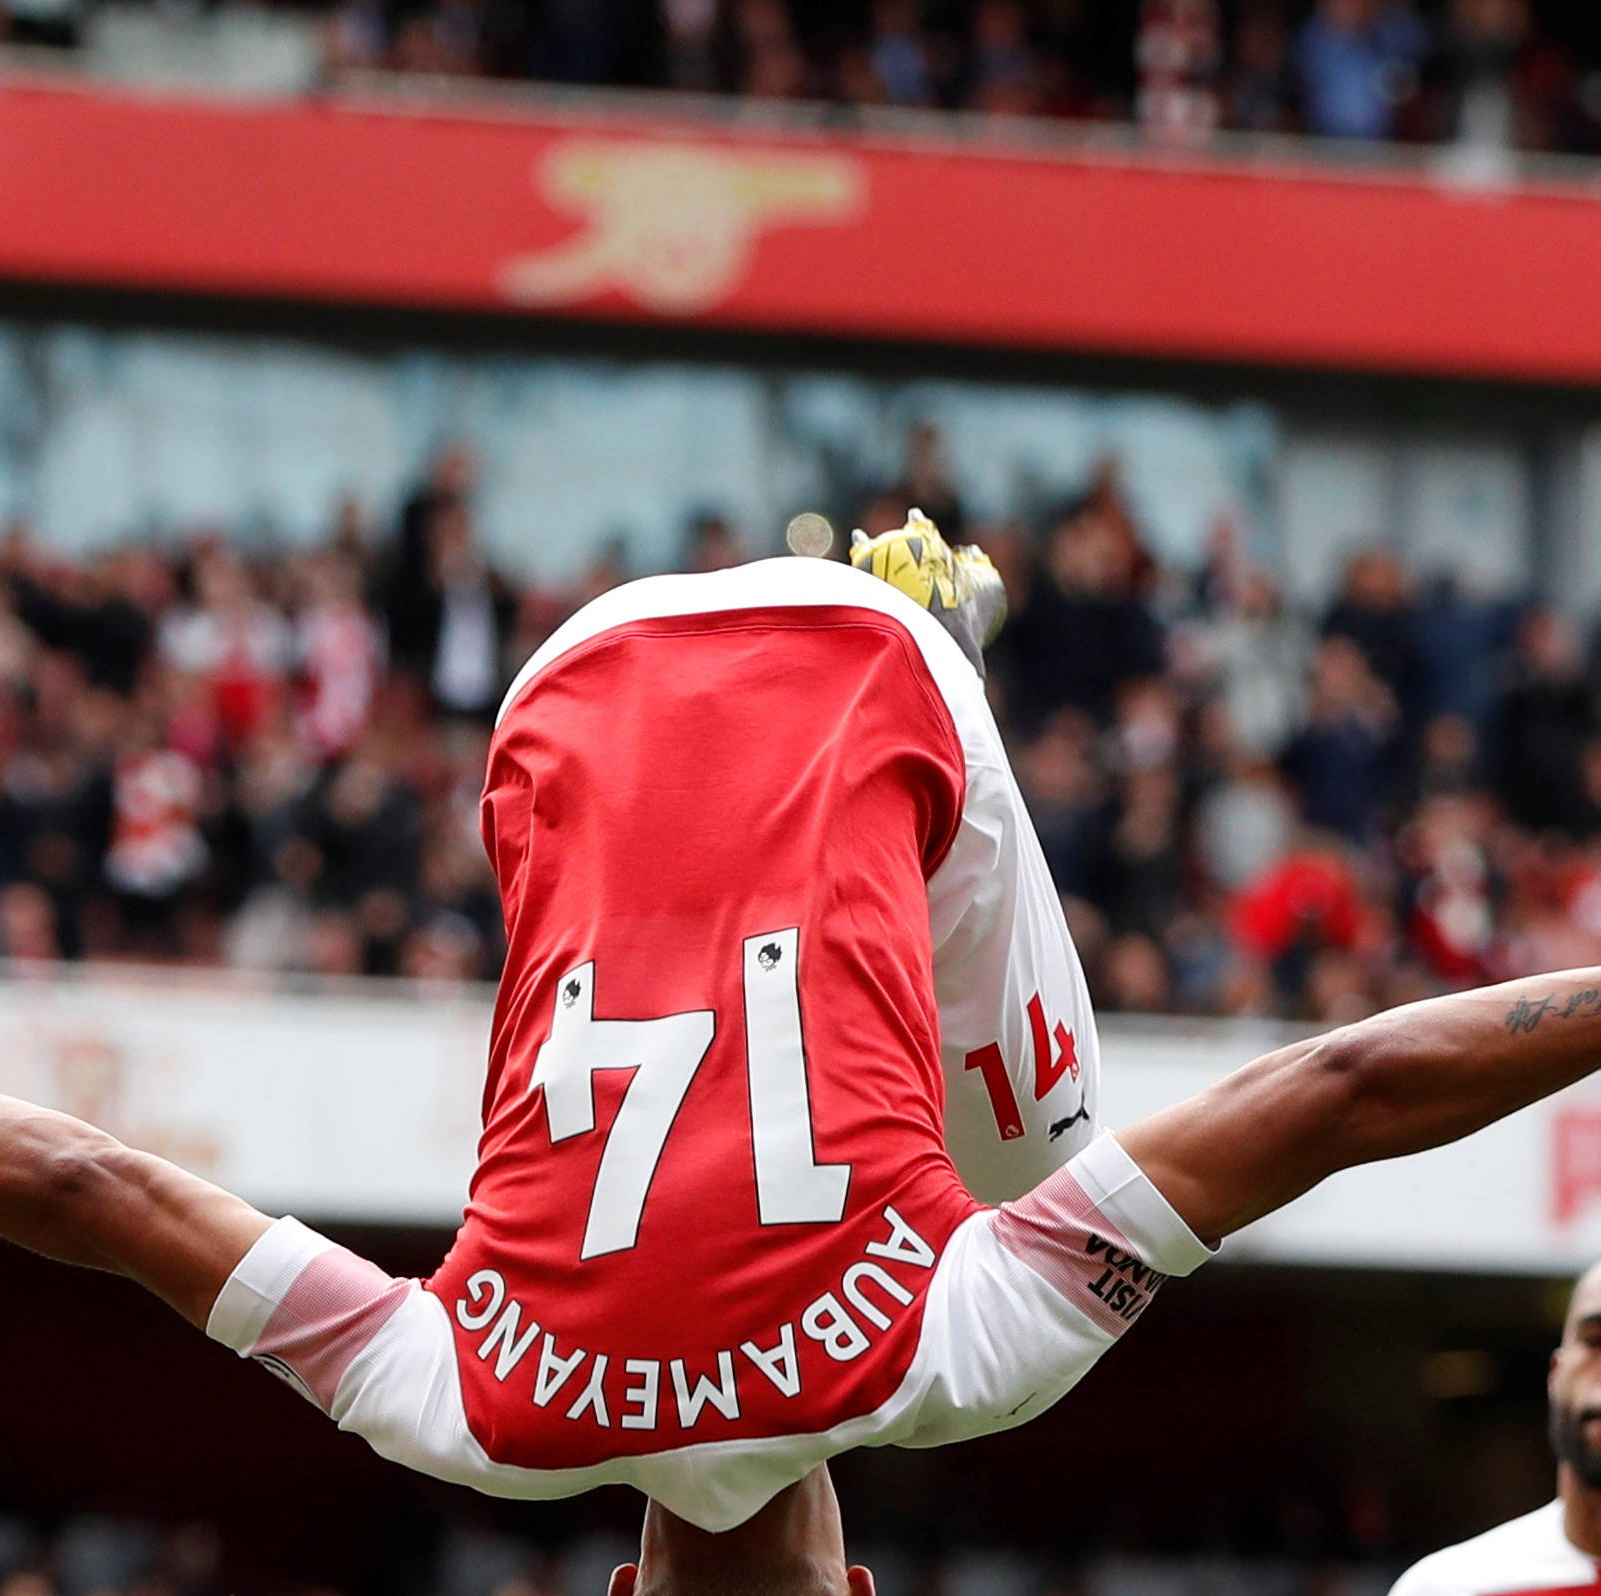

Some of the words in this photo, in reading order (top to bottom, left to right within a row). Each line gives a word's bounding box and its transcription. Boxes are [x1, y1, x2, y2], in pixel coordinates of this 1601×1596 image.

[529, 926, 852, 1262] 14
[964, 990, 1081, 1142] 14
[455, 1203, 937, 1430] AUBAMEYANG
